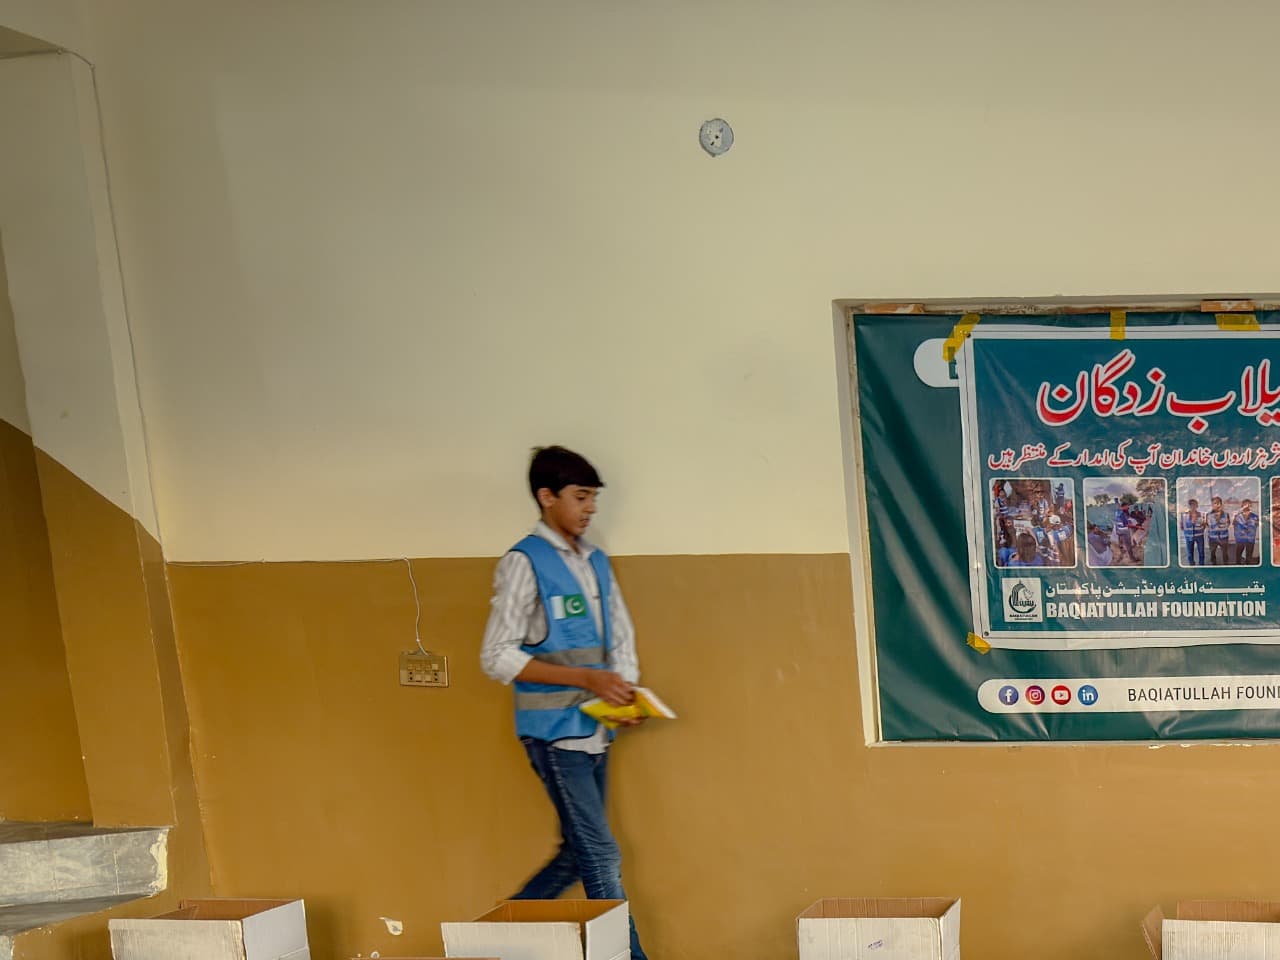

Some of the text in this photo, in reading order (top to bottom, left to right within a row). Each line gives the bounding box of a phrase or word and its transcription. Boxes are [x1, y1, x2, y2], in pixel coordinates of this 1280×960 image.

[1036, 348, 1167, 427] زدگان
[988, 446, 1014, 471] ہیں
[1047, 441, 1072, 467] کے
[1110, 439, 1133, 469] کی
[1128, 442, 1162, 474] آپ
[1046, 580, 1101, 600] پاکستان
[1046, 600, 1266, 619] BAQIATULLAH FOUNDATION
[1127, 686, 1232, 703] BAQIATULLAH
